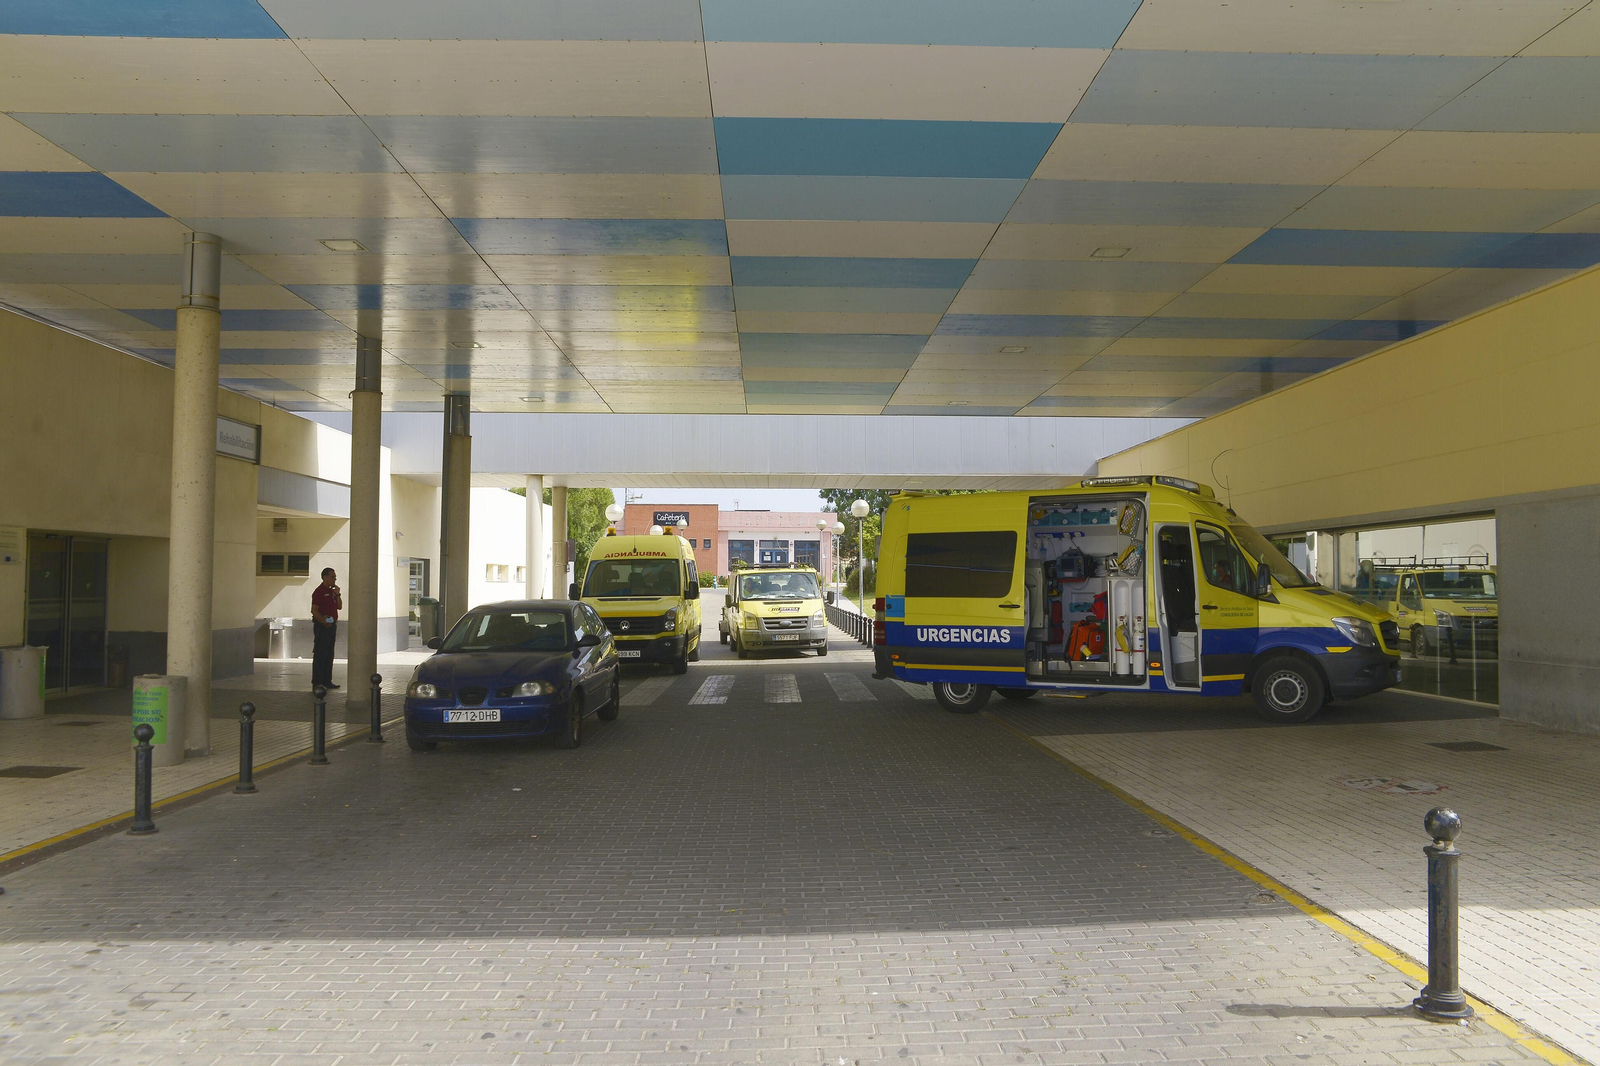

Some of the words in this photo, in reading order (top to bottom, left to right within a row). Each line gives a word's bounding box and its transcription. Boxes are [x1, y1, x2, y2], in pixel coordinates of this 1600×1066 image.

[219, 431, 255, 451] Rehabilitación
[656, 513, 686, 521] Cafetería
[916, 628, 1011, 643] URGENCIAS
[450, 711, 476, 721] 7712
[479, 711, 498, 721] DHB
